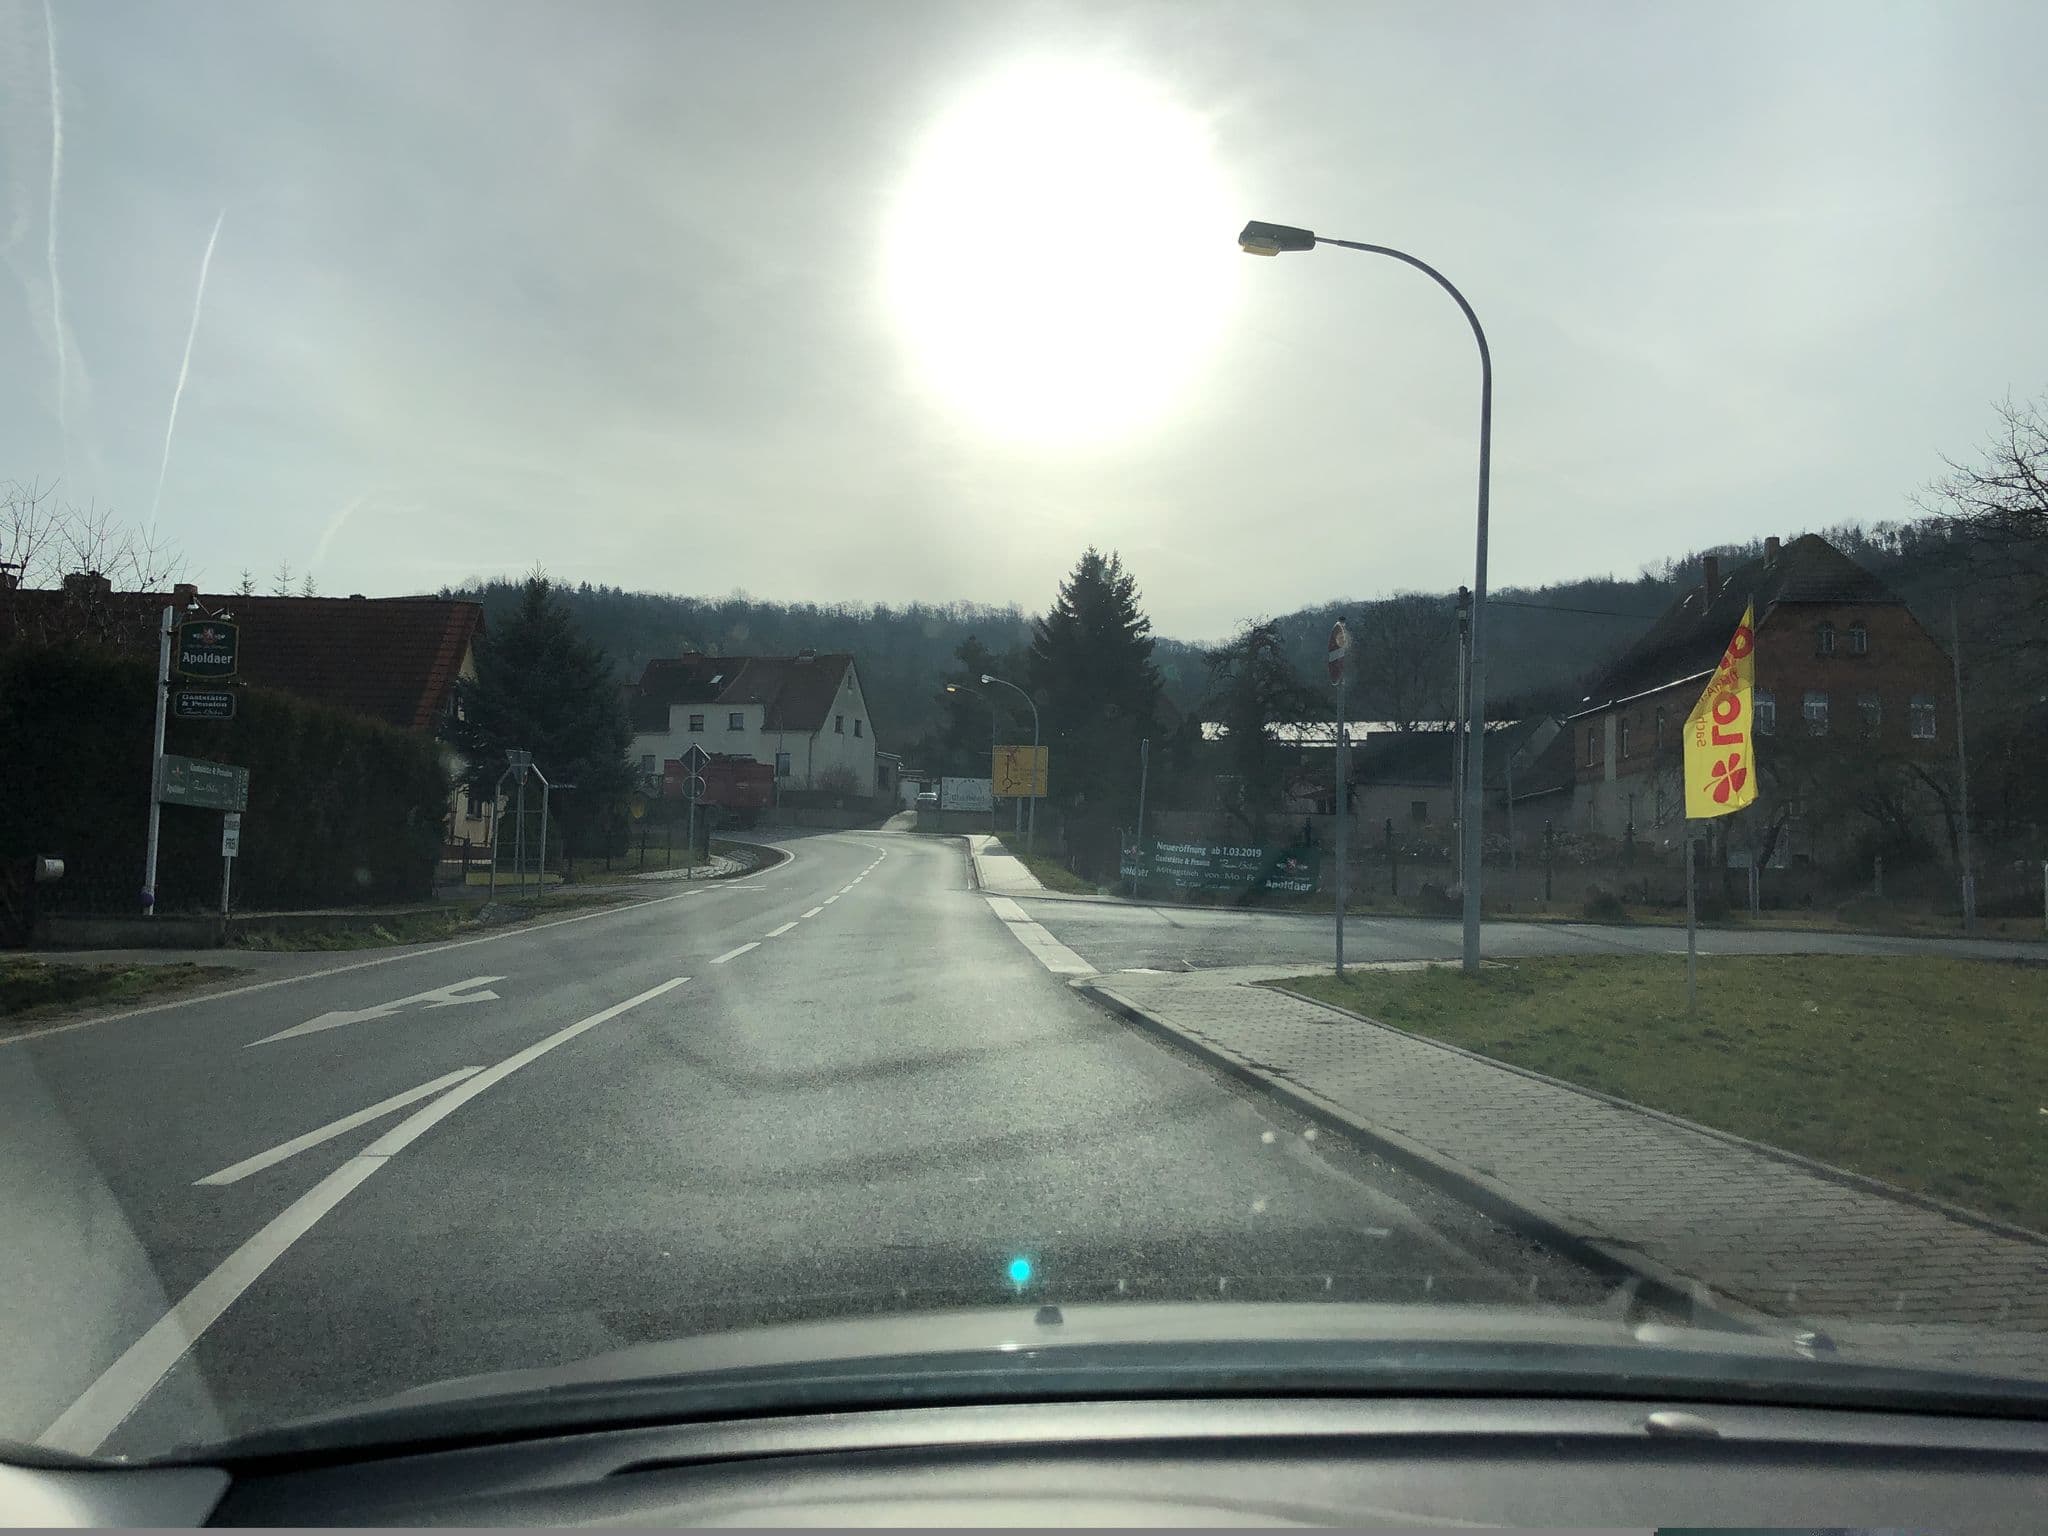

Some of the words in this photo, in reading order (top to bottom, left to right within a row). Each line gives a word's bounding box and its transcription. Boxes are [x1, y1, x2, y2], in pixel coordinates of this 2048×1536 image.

[182, 651, 233, 664] Apoldaer
[1156, 841, 1207, 857] Neueröffnung
[1211, 846, 1220, 855] ab
[1223, 846, 1263, 858] 1.03.2019
[1224, 872, 1240, 881] Mo
[1265, 879, 1313, 892] Apoldaer
